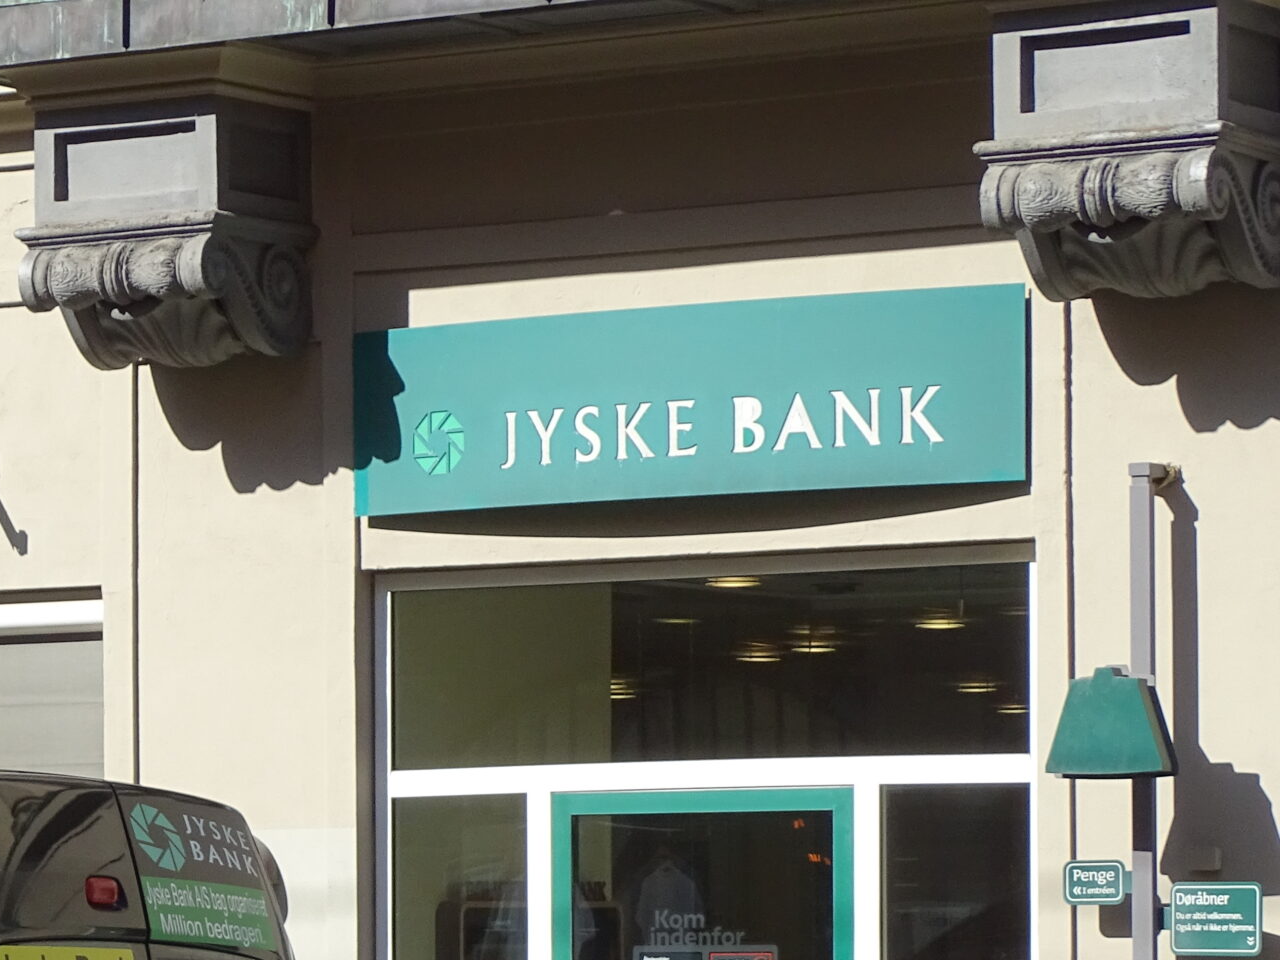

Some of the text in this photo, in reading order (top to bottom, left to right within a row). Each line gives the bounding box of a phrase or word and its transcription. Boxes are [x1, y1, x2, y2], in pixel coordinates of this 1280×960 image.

[500, 384, 944, 470] JYSKE BANK
[183, 814, 249, 850] JYSKE
[189, 840, 258, 878] BANK
[1073, 869, 1115, 885] Penge
[1176, 891, 1230, 906] Døråbner
[160, 913, 203, 936] Million
[654, 910, 705, 929] Kom
[1176, 912, 1185, 920] Du
[650, 927, 746, 946] indenfor
